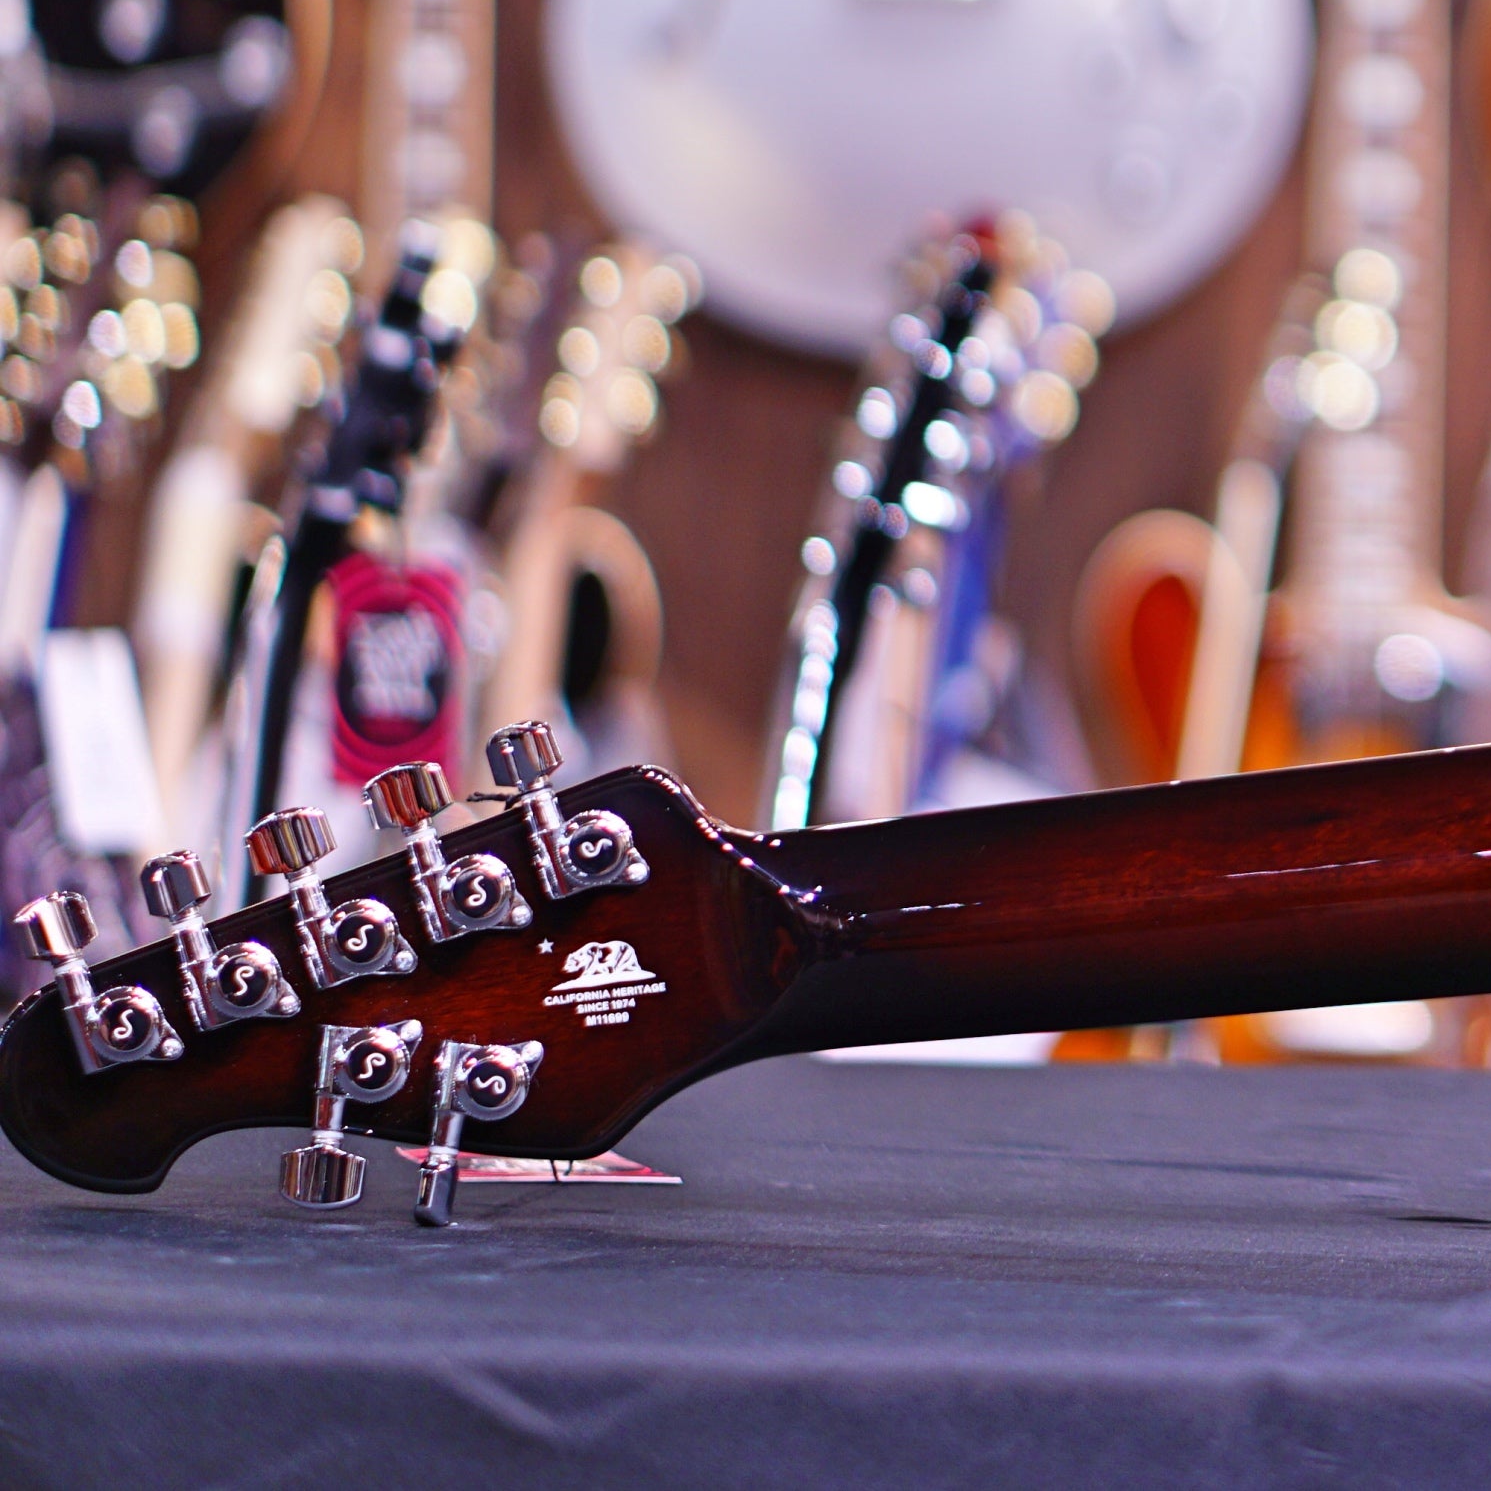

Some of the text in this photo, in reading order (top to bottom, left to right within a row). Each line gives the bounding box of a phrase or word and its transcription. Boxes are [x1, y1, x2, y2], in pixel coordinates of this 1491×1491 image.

[543, 982, 666, 1006] CALIFORNIA HERITAGE
[576, 998, 636, 1014] SINCE 1974
